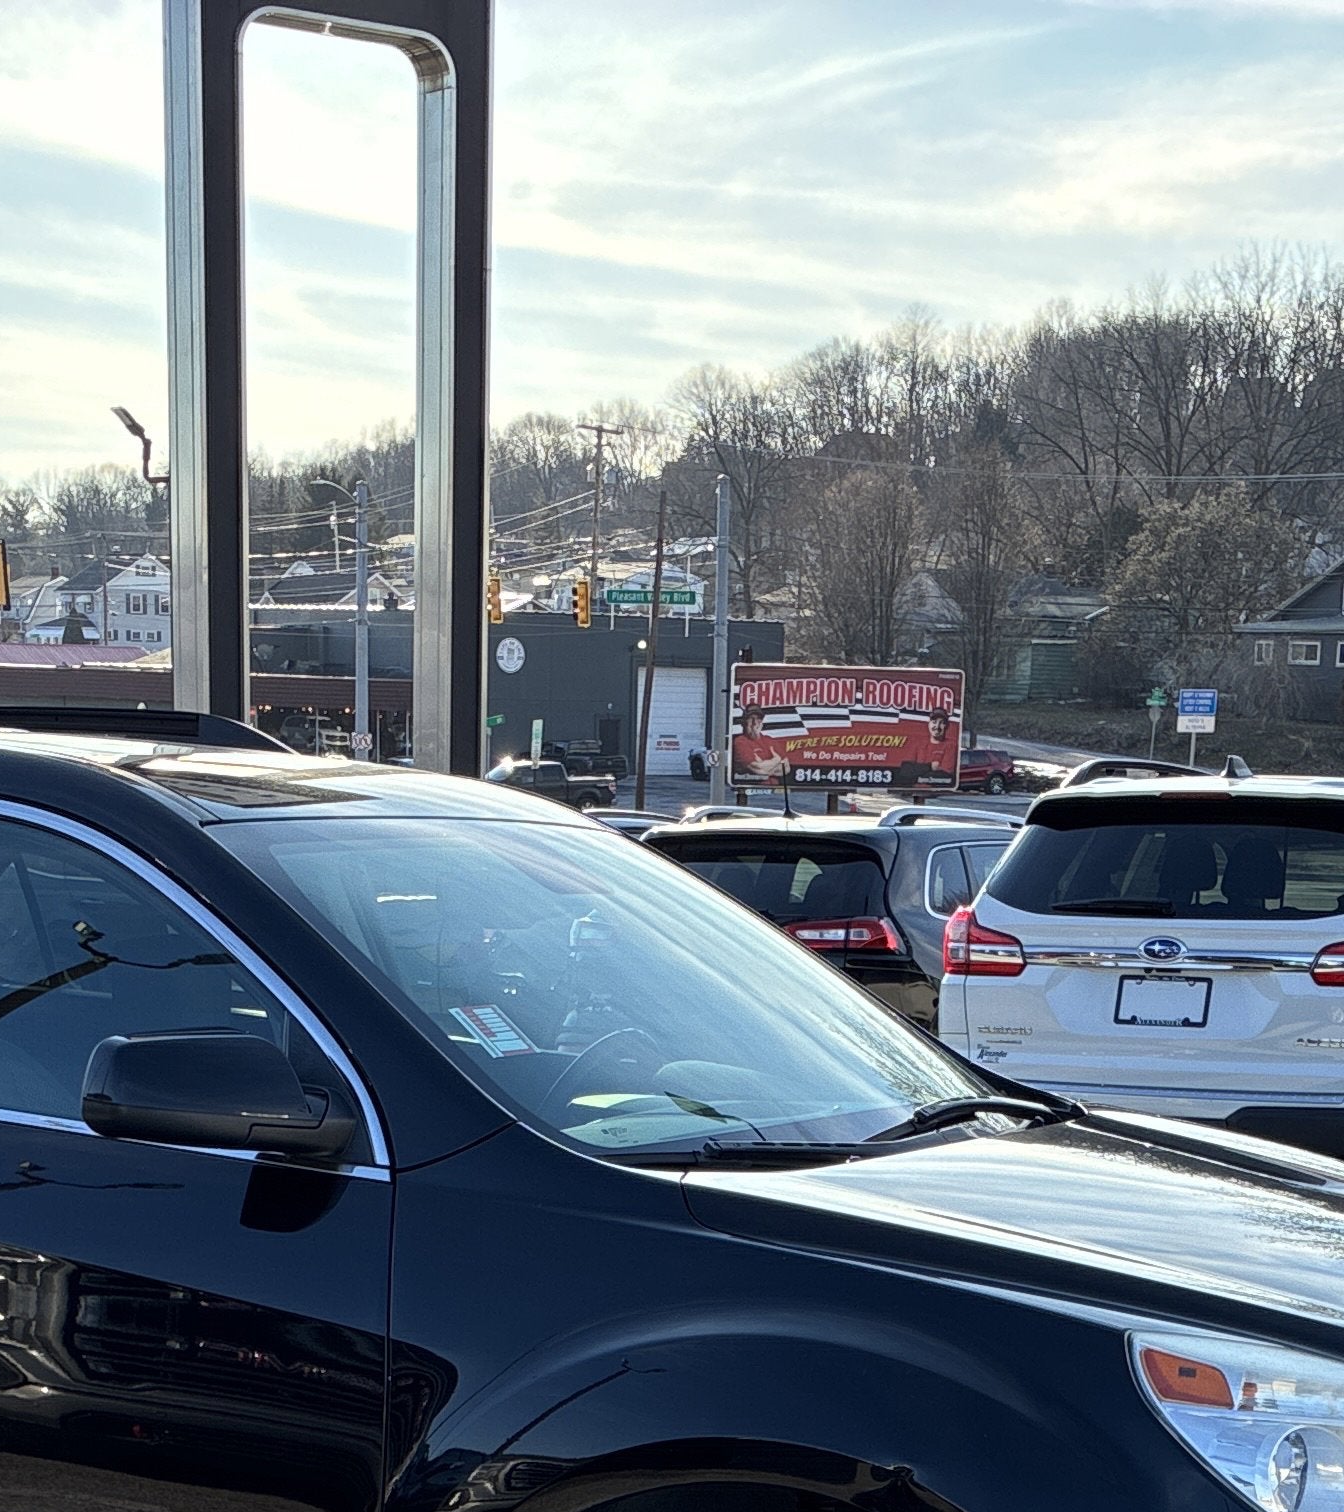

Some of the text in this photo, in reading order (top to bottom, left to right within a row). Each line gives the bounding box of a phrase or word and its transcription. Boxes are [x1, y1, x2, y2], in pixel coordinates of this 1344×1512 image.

[611, 591, 691, 604] Pleasant Vley Blvd
[740, 678, 955, 716] CHAMPION ROOFING
[785, 735, 907, 753] WE'RE THE SOLUTION!
[803, 751, 887, 762] We Do Repairs Too!
[795, 768, 893, 783] 814-414-8183
